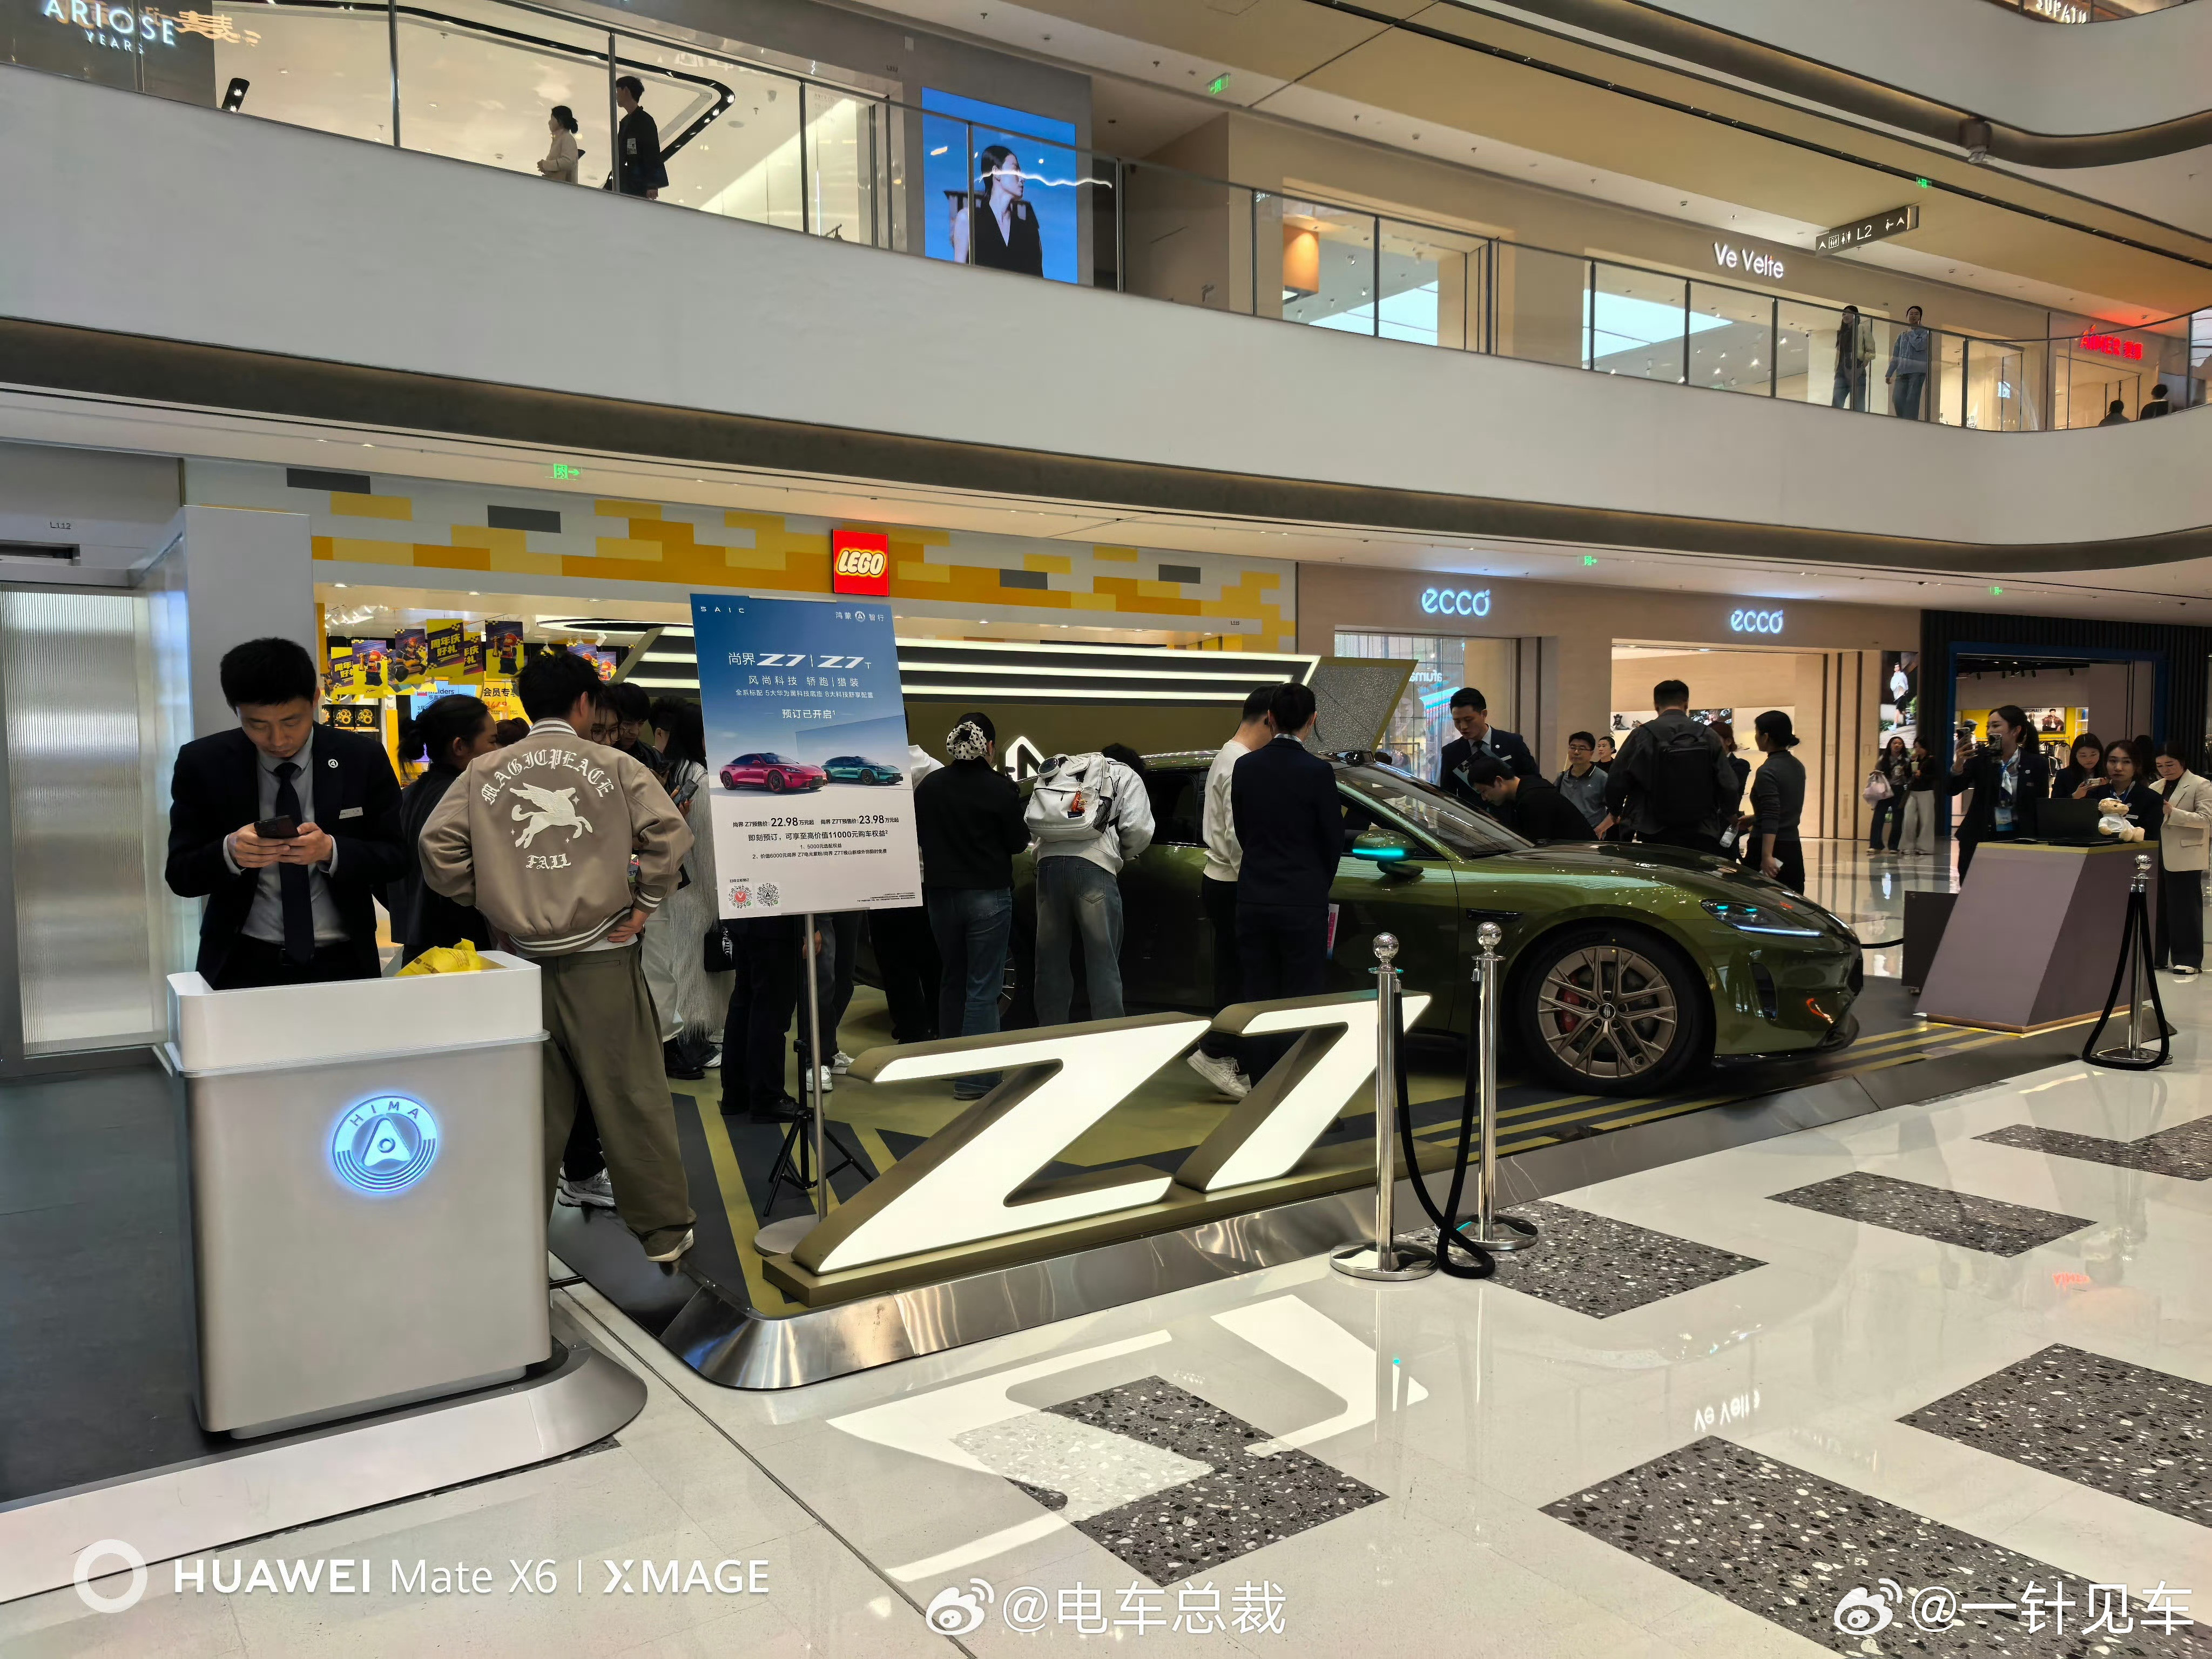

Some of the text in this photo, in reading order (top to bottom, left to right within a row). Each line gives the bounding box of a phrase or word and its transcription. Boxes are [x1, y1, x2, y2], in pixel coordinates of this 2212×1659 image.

[43, 0, 177, 46] ARIOSE
[85, 29, 145, 55] YEARS
[1857, 225, 1872, 241] L2
[1714, 241, 1784, 279] Ve Velte
[837, 549, 885, 576] LEGO
[700, 606, 745, 614] SAIC
[1420, 588, 1492, 617] ecco
[835, 611, 885, 622] 鸿蒙 智行
[1730, 609, 1784, 634] ecco
[430, 633, 461, 650] 周年庆
[437, 647, 458, 657] 好礼
[729, 652, 756, 666] 尚界
[757, 653, 806, 667] Z7
[334, 661, 353, 672] 周年
[748, 676, 798, 686] 风尚科技
[736, 689, 873, 699] 全系标配 5大华为黑科技底座 8大科技舒享配置
[481, 748, 615, 806] MAGICPEACE
[525, 853, 571, 869] FALL
[349, 1101, 419, 1127] HIMA
[792, 990, 1432, 1277] Z7
